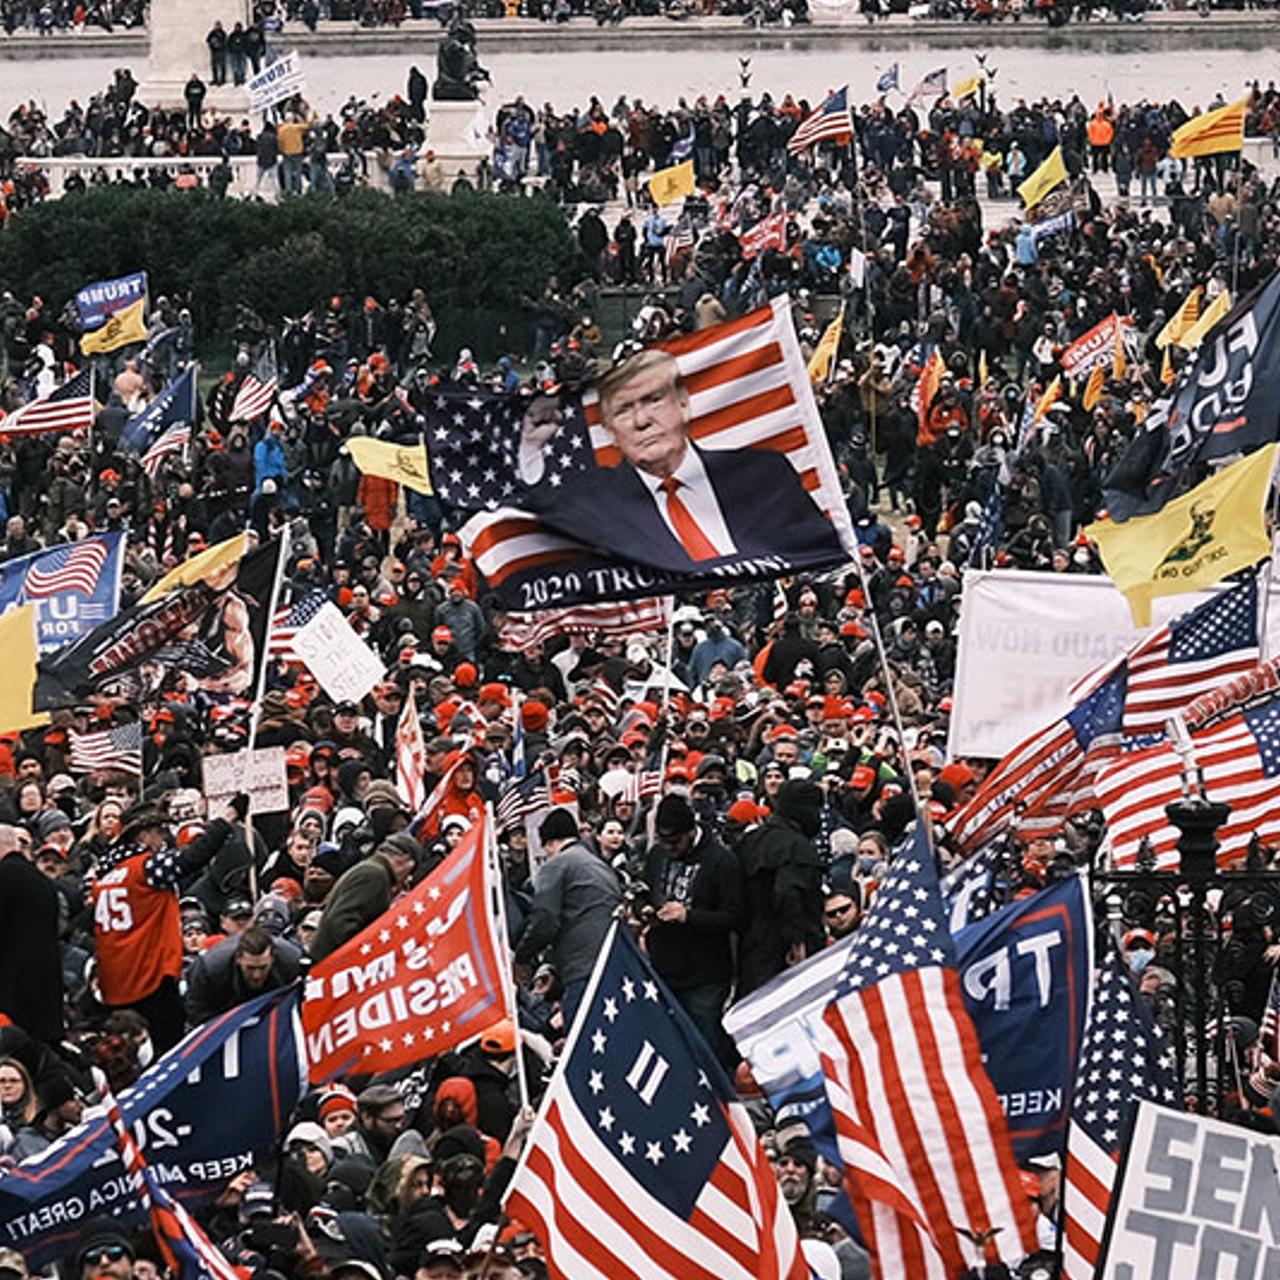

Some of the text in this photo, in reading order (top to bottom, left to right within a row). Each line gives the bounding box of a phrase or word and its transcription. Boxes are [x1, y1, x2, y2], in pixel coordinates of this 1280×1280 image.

[521, 574, 582, 609] 2020
[588, 563, 670, 596] TRU
[95, 887, 133, 932] 45
